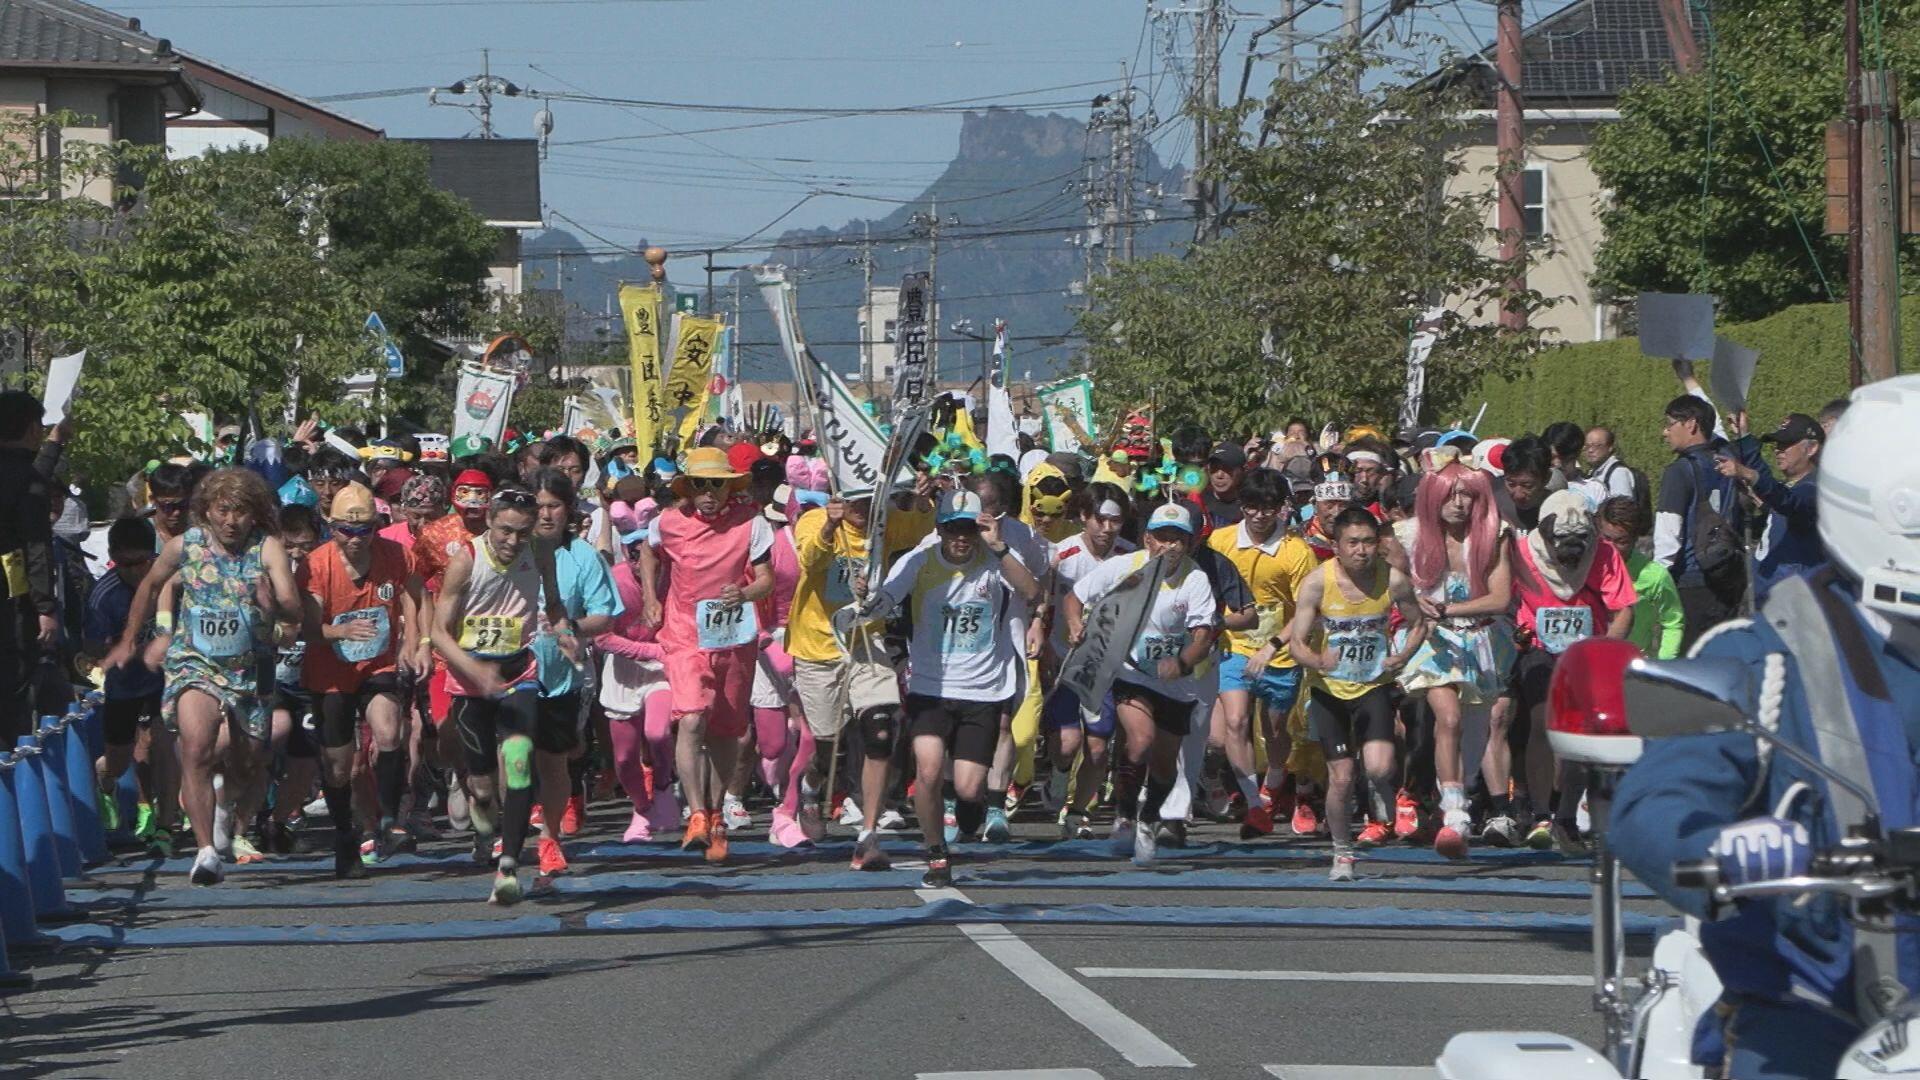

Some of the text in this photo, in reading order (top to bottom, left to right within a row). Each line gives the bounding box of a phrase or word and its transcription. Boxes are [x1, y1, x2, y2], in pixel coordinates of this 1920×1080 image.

[200, 619, 240, 637] 1069
[943, 615, 980, 634] 1135
[1545, 618, 1583, 634] 1579
[1339, 645, 1376, 662] 1418
